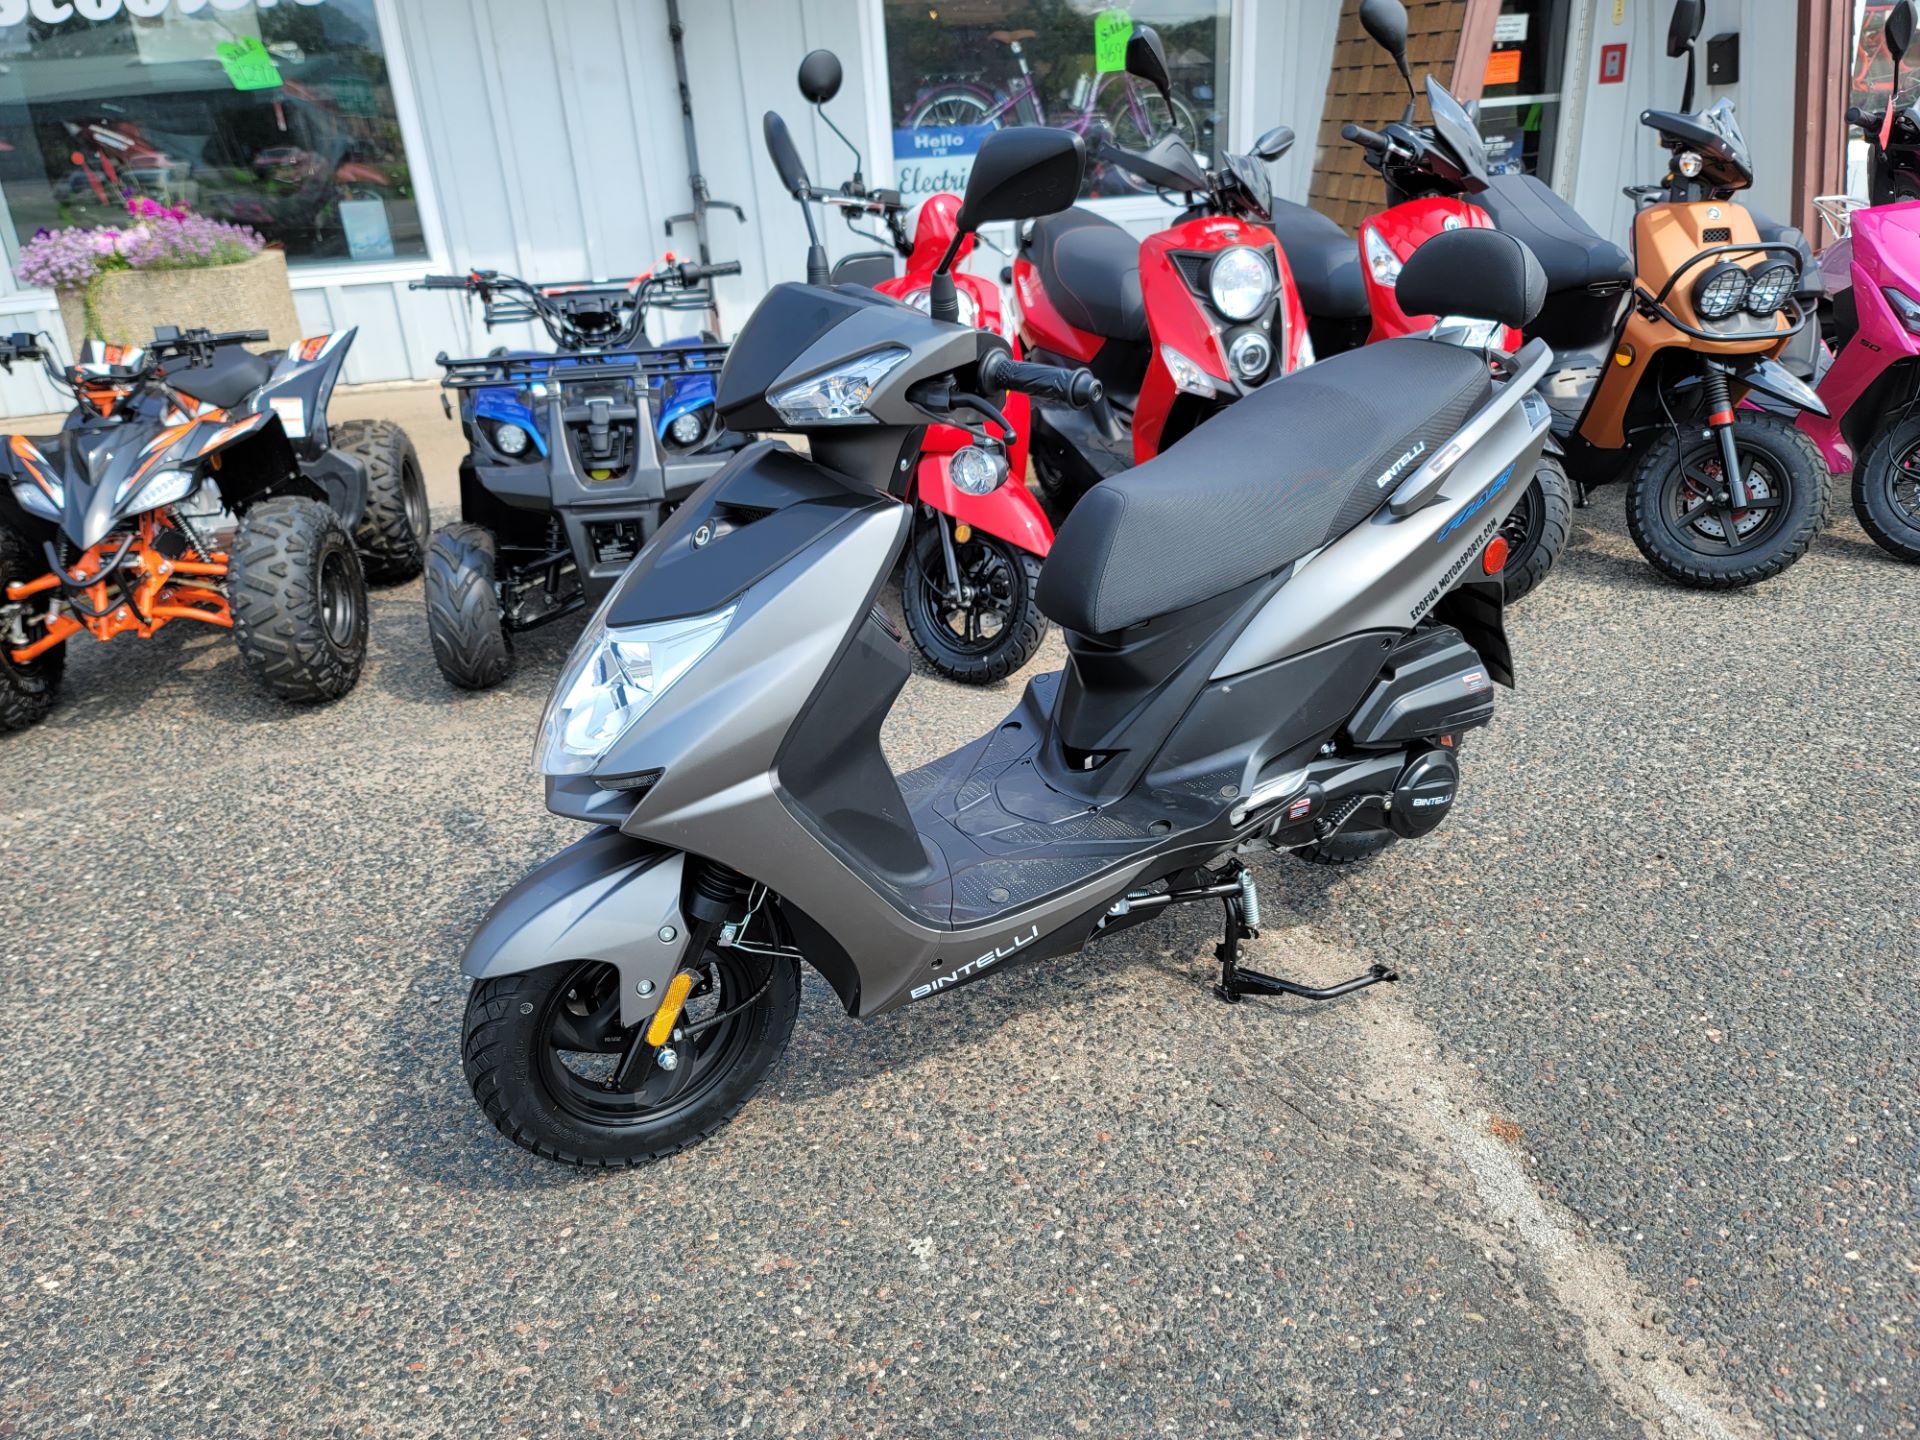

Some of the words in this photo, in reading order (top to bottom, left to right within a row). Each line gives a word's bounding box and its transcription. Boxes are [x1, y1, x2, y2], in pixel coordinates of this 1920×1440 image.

[914, 133, 965, 149] Hello
[899, 166, 967, 194] Electri
[1376, 440, 1426, 488] BINTELLI
[1410, 587, 1440, 621] ECOFUN
[1439, 517, 1499, 591] MOTORSPORTS.COM
[1412, 793, 1453, 807] BINTELLI
[910, 924, 1039, 999] BINTELLI
